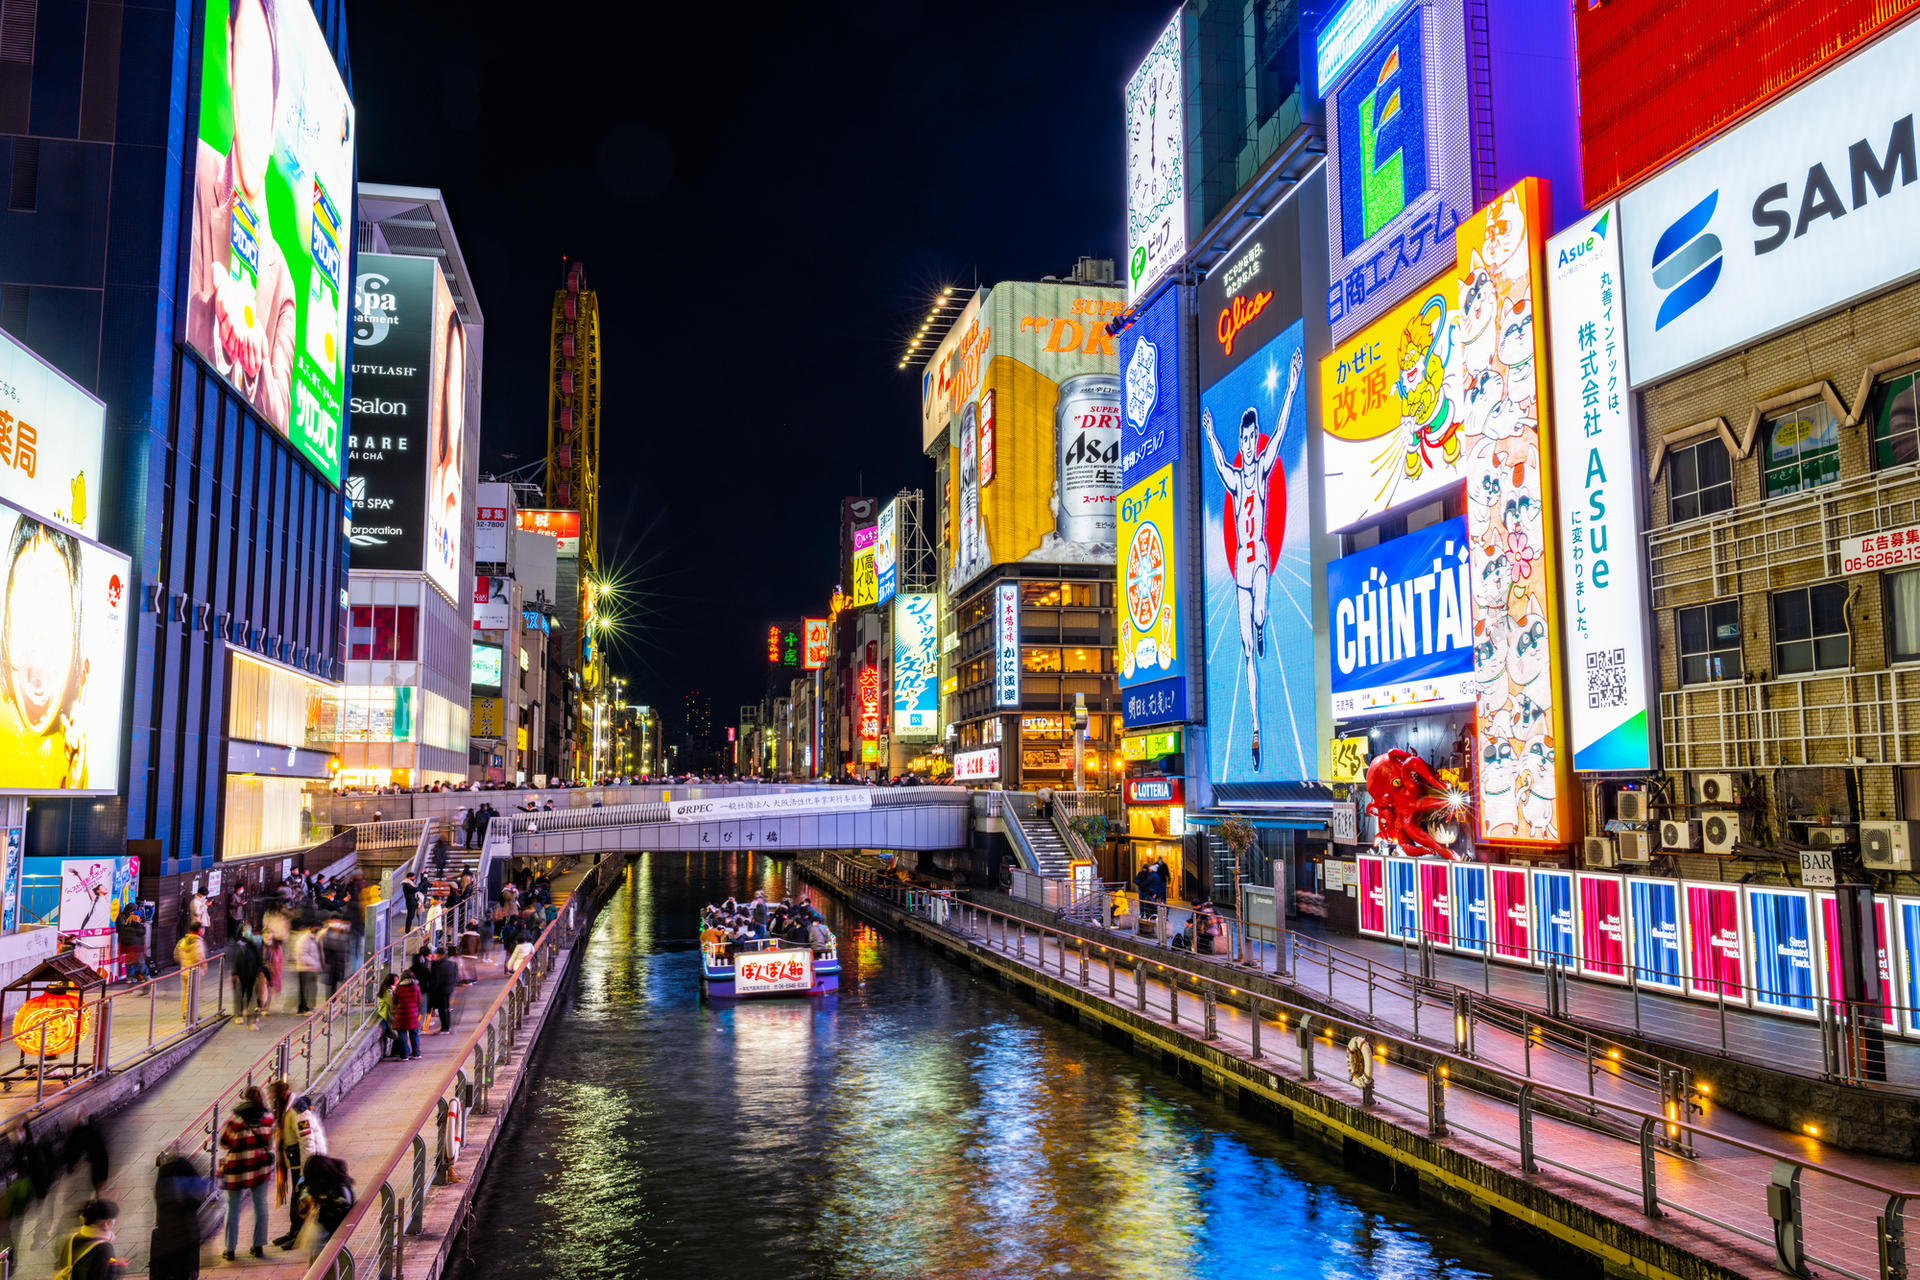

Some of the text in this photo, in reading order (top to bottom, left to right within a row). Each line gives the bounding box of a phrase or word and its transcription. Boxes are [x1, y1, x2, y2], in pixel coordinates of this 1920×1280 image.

[1752, 113, 1918, 256] SAM
[1148, 217, 1170, 261] ピップ
[1558, 237, 1594, 269] Asue
[1328, 200, 1459, 327] 日商エステム
[1070, 297, 1133, 317] SUPE
[1217, 290, 1273, 356] Glico
[1336, 341, 1382, 385] かぜに
[1600, 271, 1620, 415] 丸善インテックは、
[350, 397, 407, 416] Salon
[1090, 405, 1119, 414] SUPER
[1332, 363, 1388, 431] 改源
[1122, 430, 1165, 473] 雪印メグミルク
[1578, 320, 1609, 589] 株式会社 Asue
[1095, 470, 1116, 484] 生
[1243, 490, 1256, 563] グリコ
[1862, 528, 1920, 553] 広告募集
[1571, 510, 1589, 640] に変わりました。
[1336, 548, 1473, 675] CHINTAI
[860, 667, 880, 737] 大阪王将
[1137, 782, 1169, 798] LOTTERIA
[1801, 854, 1833, 870] BAR
[741, 960, 804, 983] ぽんぽん船
